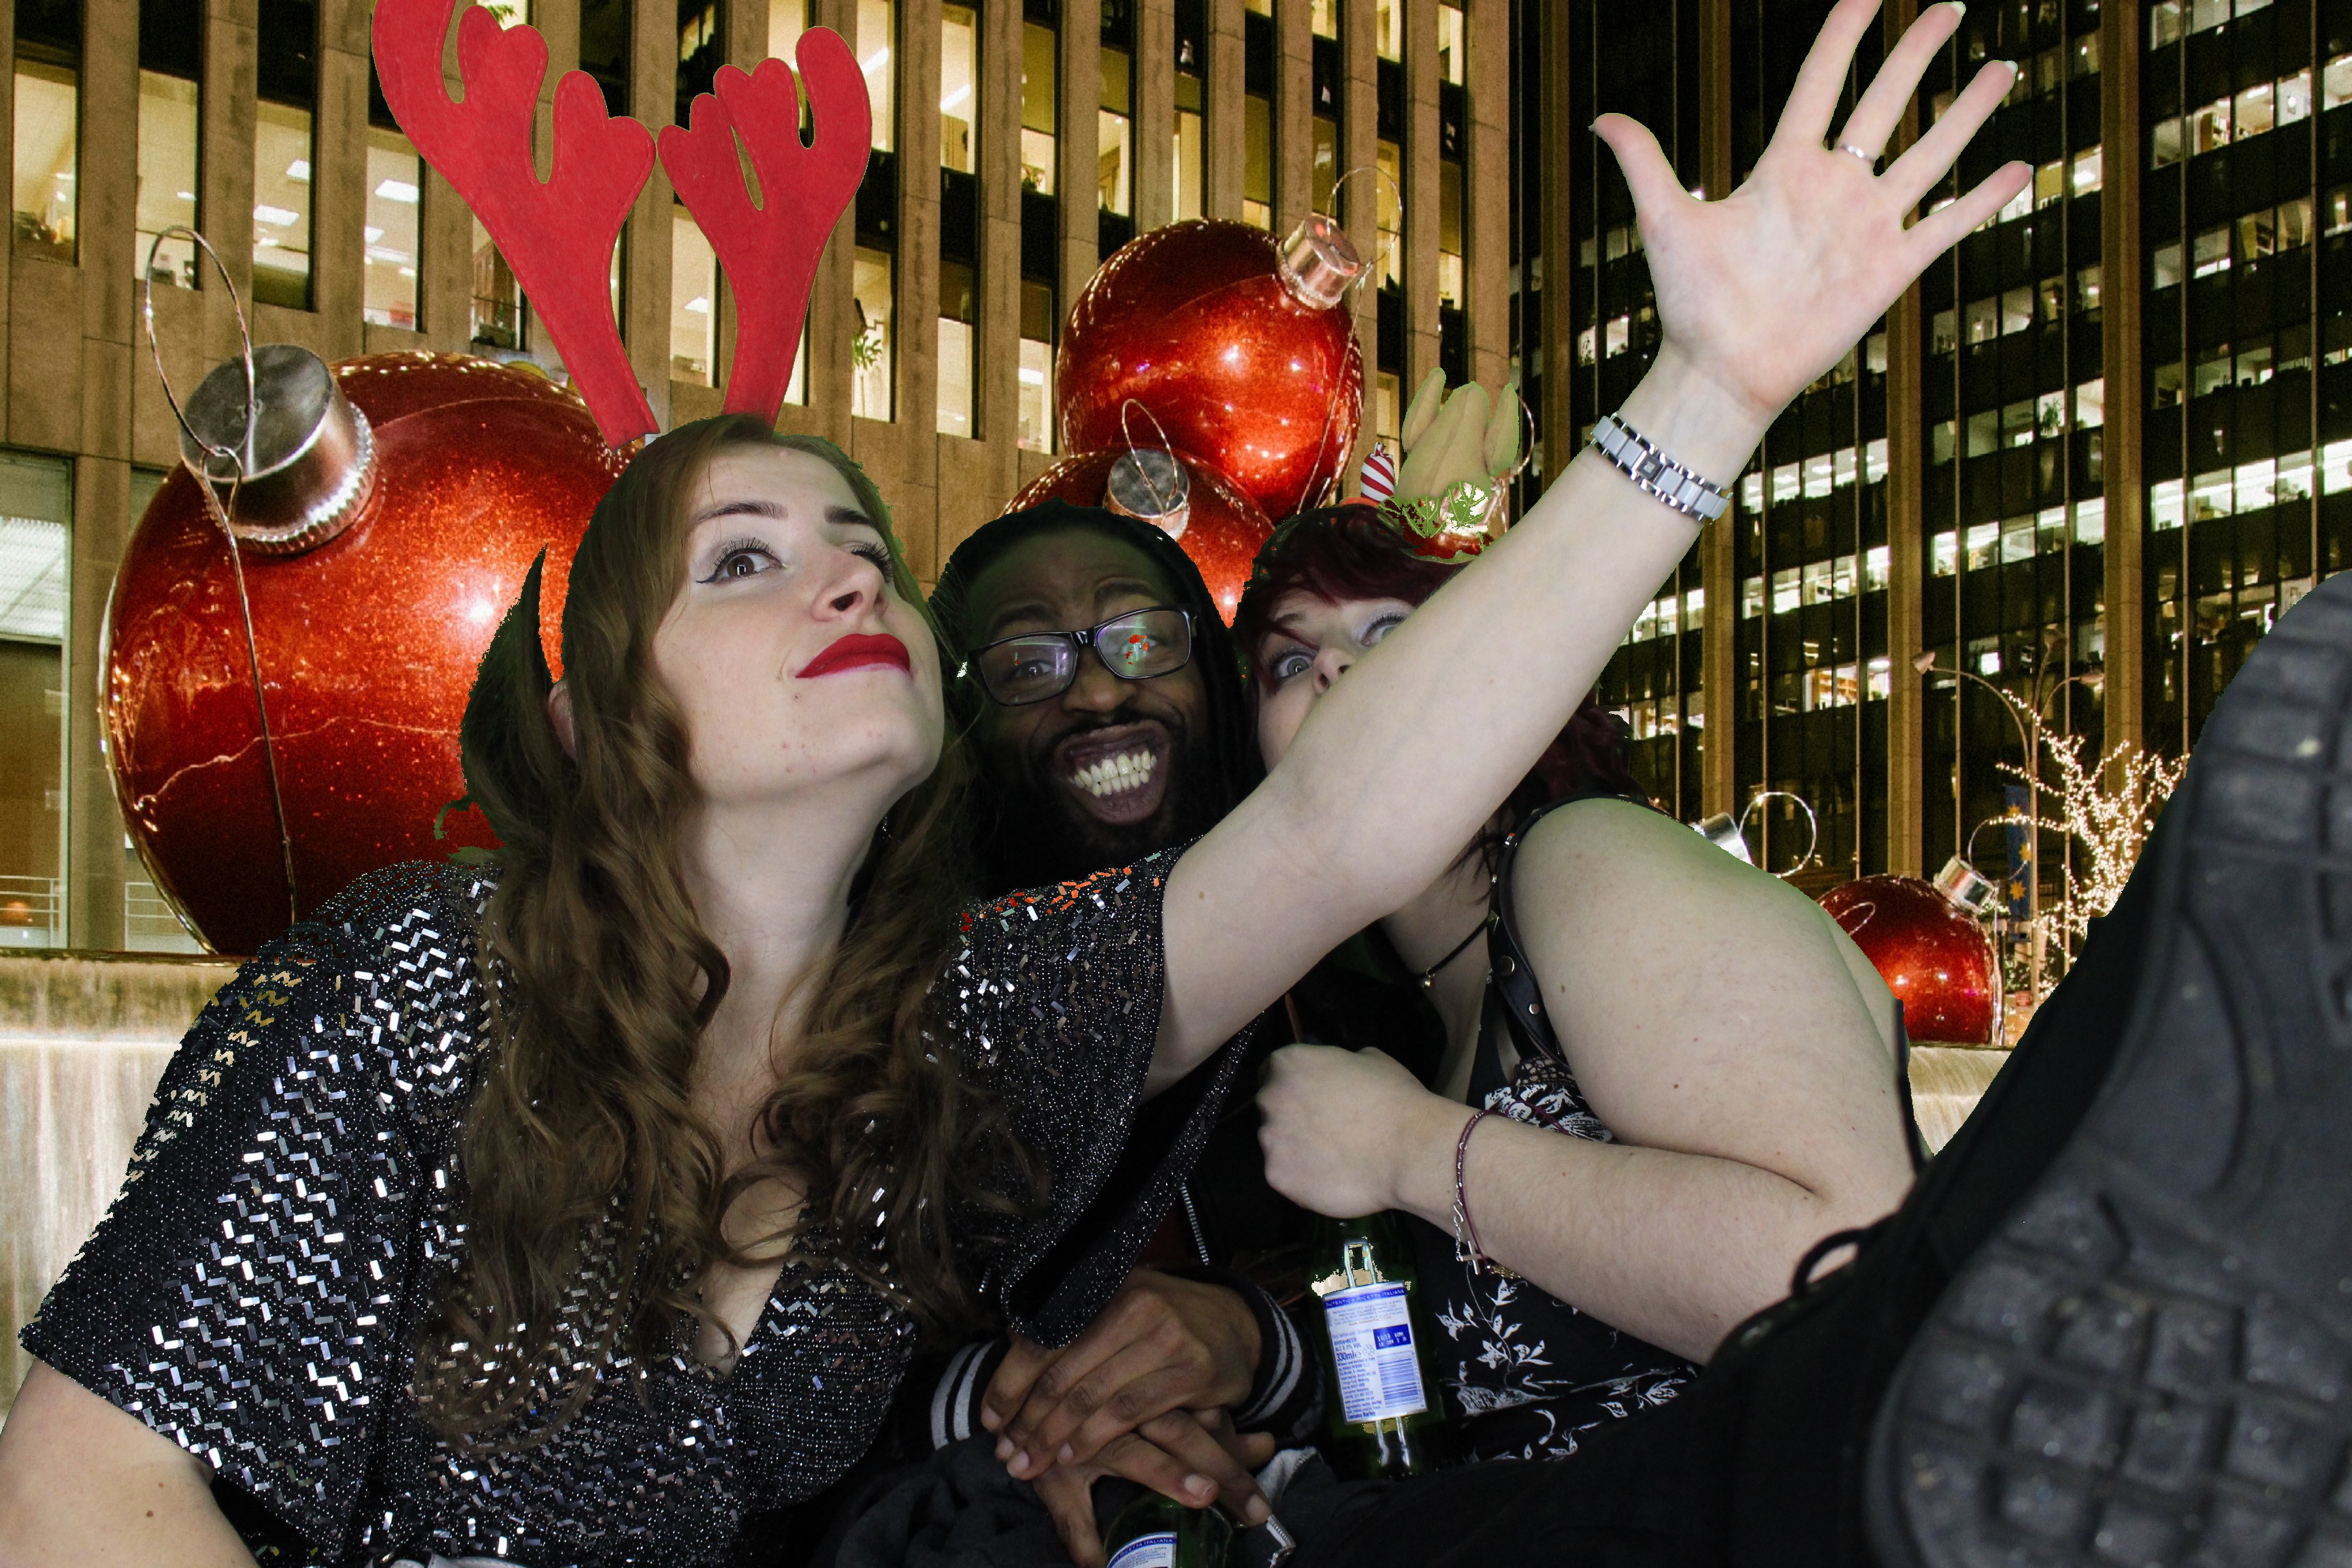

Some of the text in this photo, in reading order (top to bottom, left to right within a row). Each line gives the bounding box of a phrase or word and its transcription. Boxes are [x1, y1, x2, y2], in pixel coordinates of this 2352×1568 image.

[1326, 1288, 1405, 1307] AUTENTICA RICETTA ITALIANA
[1337, 1350, 1355, 1362] 330ml
